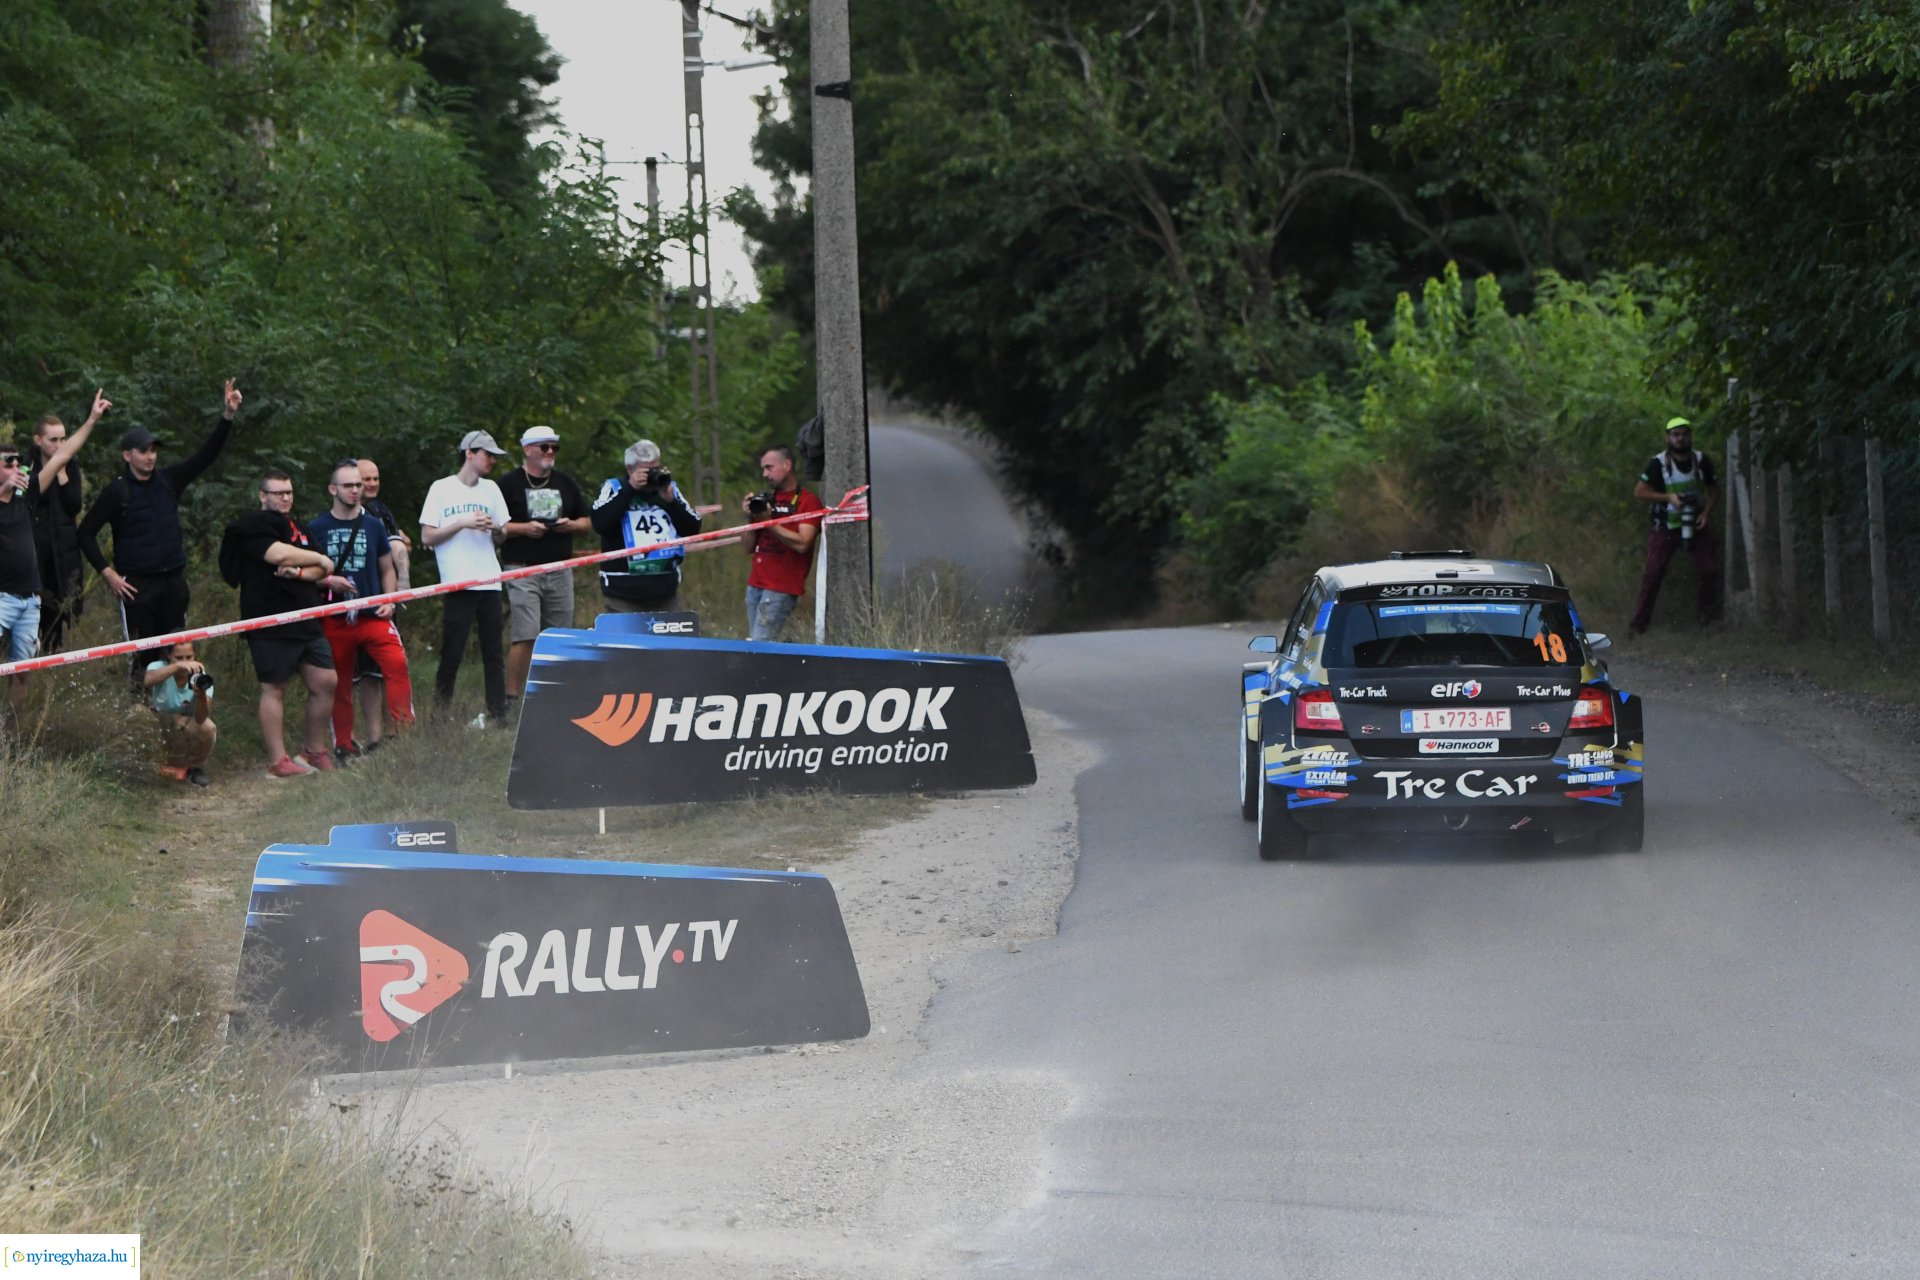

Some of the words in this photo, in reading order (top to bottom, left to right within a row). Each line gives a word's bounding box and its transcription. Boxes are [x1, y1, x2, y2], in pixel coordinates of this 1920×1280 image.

[444, 503, 489, 518] CALIFORN
[1403, 584, 1453, 597] TOP
[653, 621, 694, 634] ERC
[1533, 632, 1567, 663] 18
[1339, 687, 1365, 698] Tre-Car
[1366, 685, 1387, 698] Truck
[1431, 682, 1462, 698] elf
[1516, 685, 1551, 697] Tre-Car
[1552, 684, 1572, 697] Plus
[724, 745, 824, 774] driving
[831, 738, 949, 766] emotion
[1301, 751, 1349, 761] ZENIT
[1373, 770, 1446, 800] Tre
[1455, 769, 1538, 798] Car
[397, 831, 447, 847] ERC
